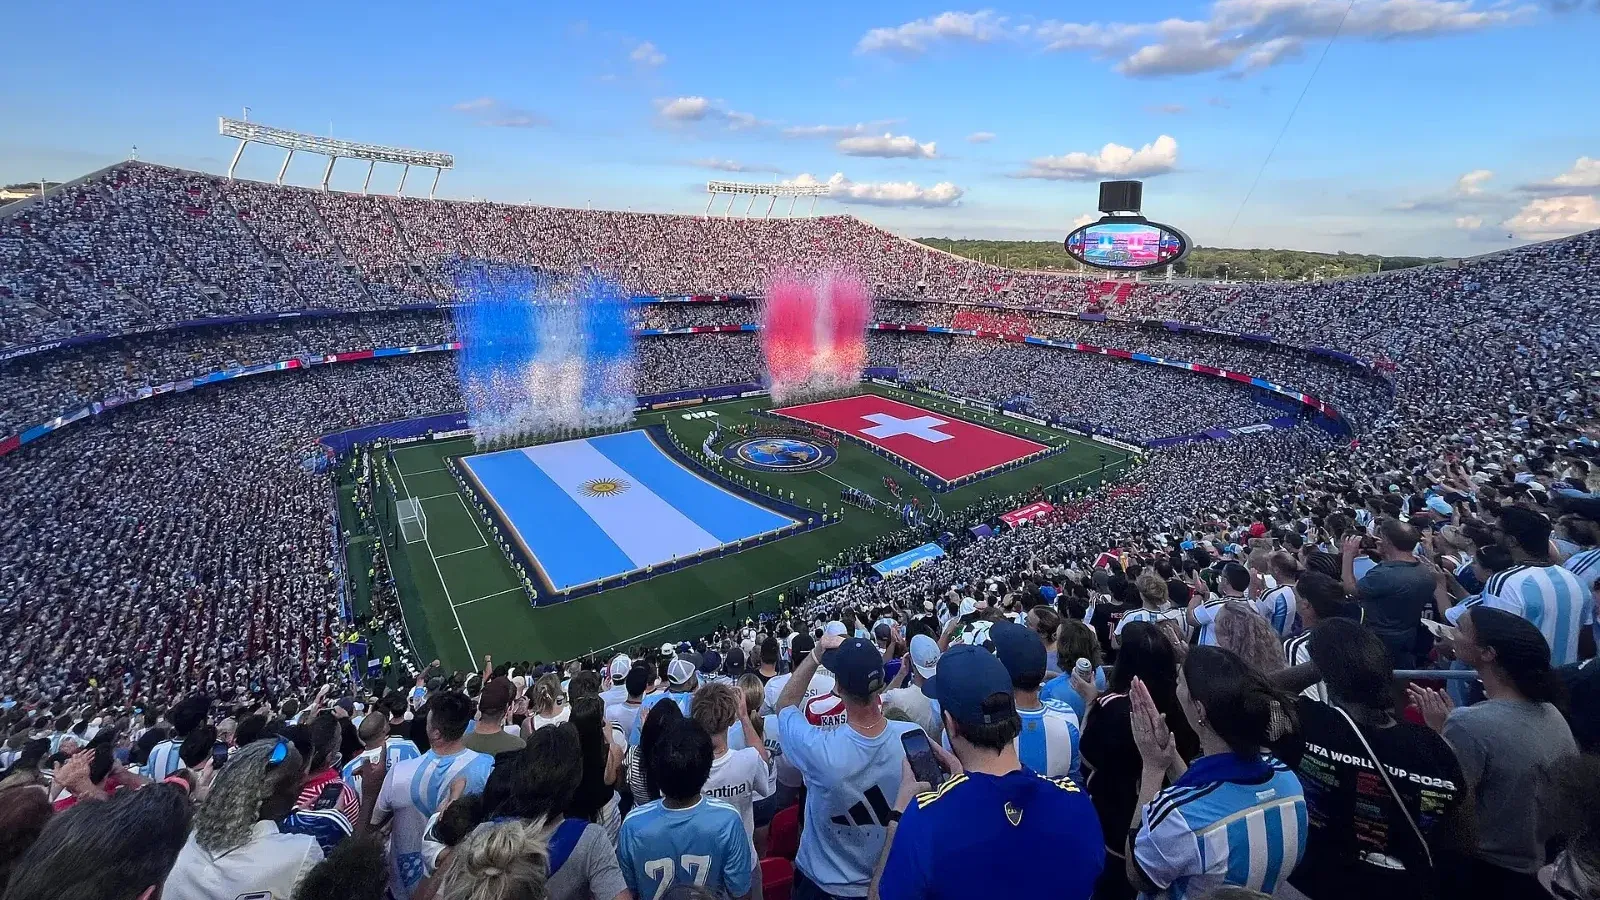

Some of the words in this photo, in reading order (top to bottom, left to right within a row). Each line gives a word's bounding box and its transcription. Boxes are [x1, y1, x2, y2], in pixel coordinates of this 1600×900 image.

[39, 342, 61, 350] CITY
[804, 688, 818, 698] SSI
[821, 714, 846, 727] KANS
[706, 782, 746, 799] entina
